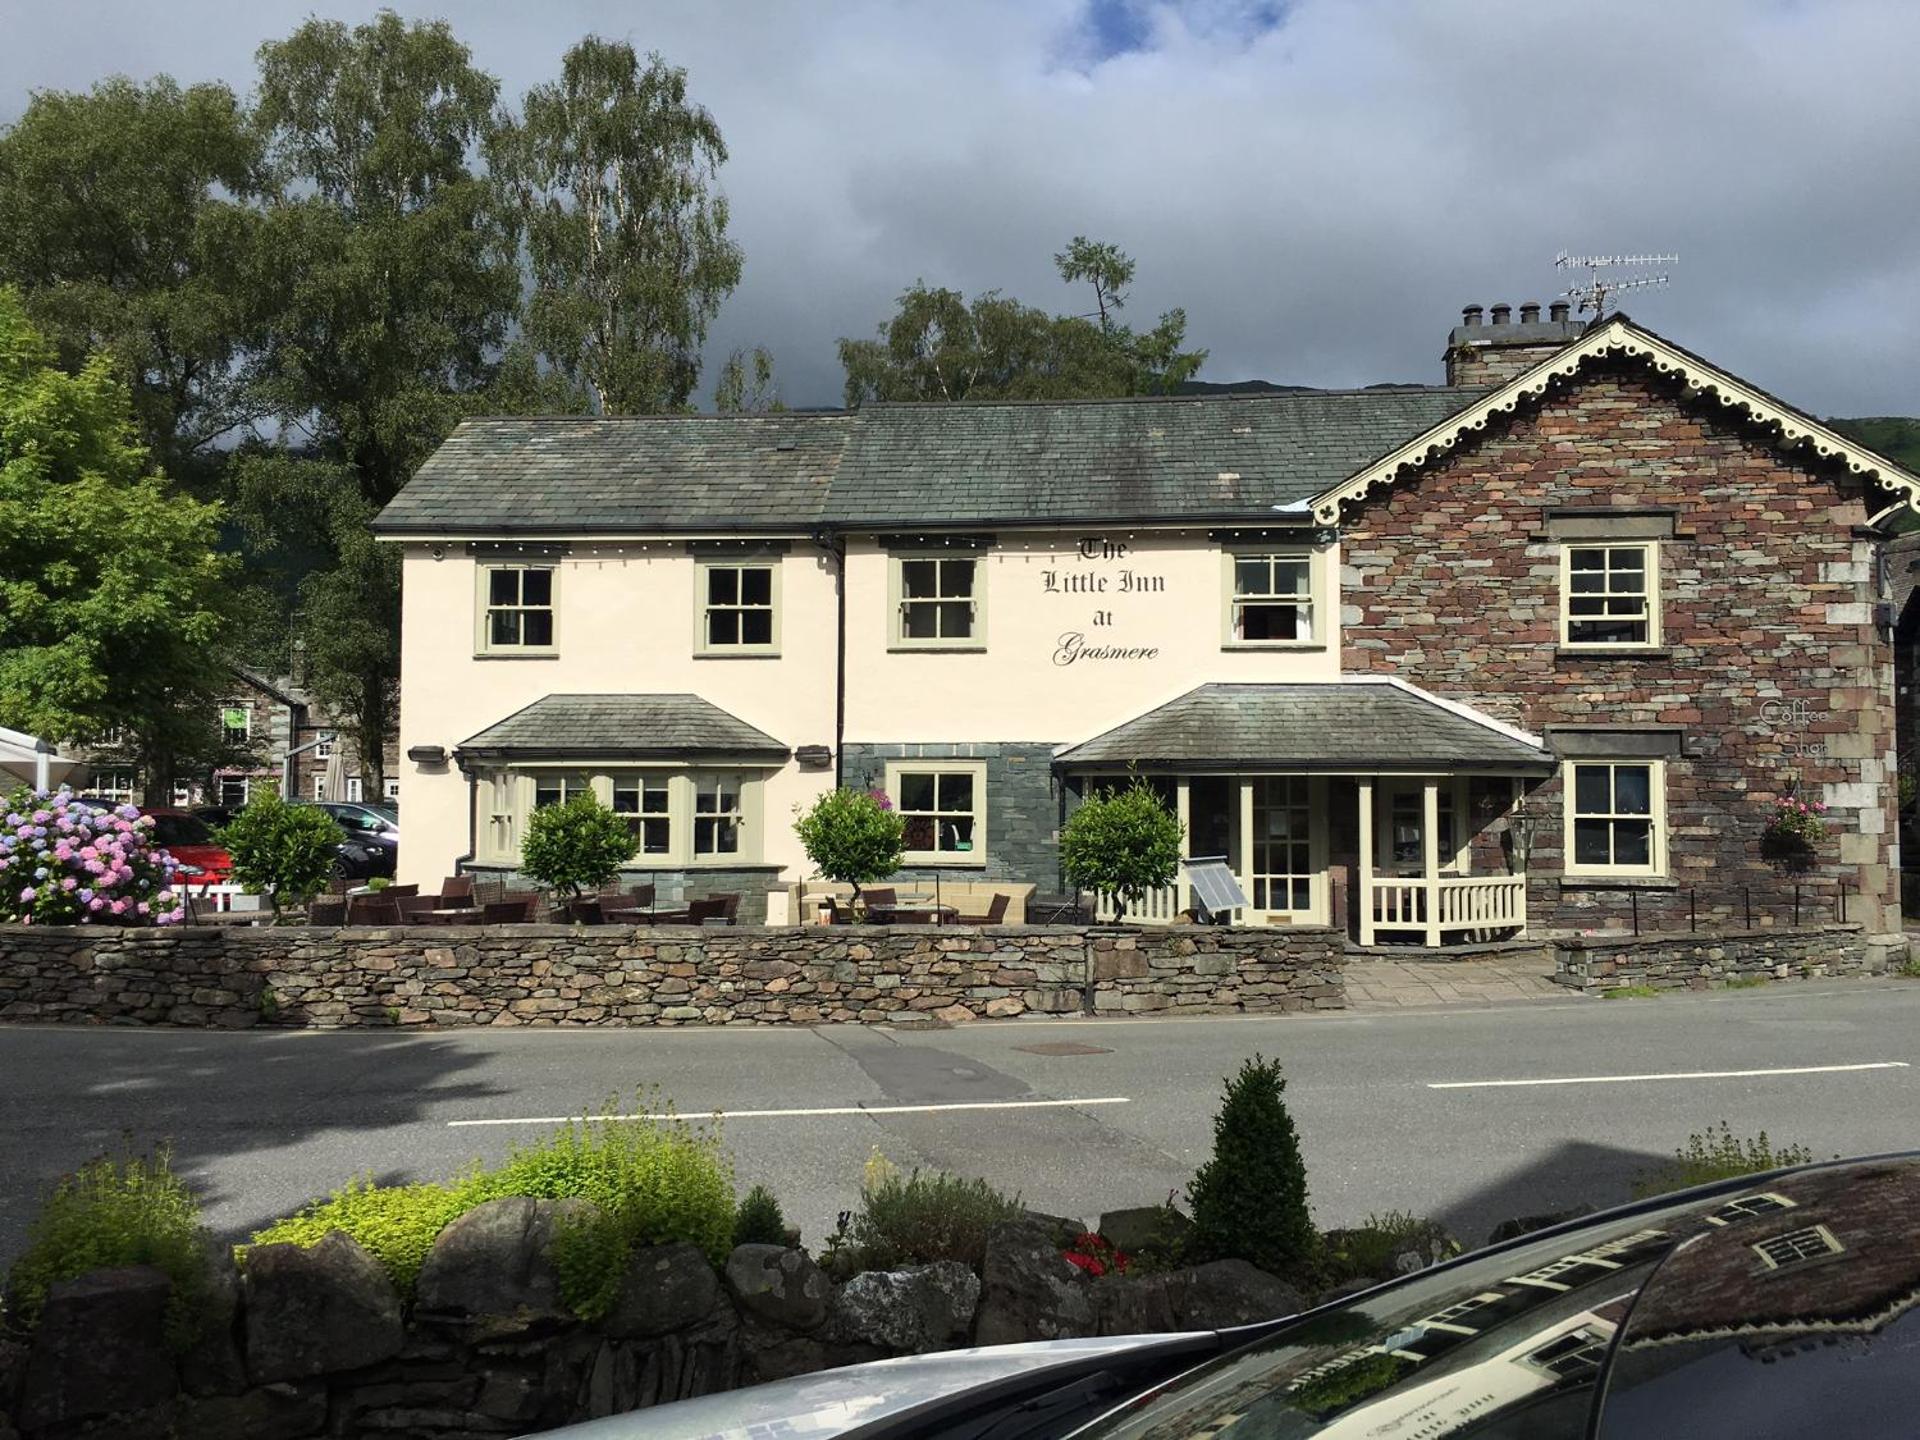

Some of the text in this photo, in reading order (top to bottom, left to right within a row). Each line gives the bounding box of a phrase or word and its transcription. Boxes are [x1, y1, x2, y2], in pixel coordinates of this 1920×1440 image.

[1080, 537, 1128, 562] The
[1041, 570, 1165, 593] Little Inn
[1093, 610, 1113, 626] at
[1052, 631, 1159, 667] Grasmere
[1760, 699, 1829, 727] Coffee
